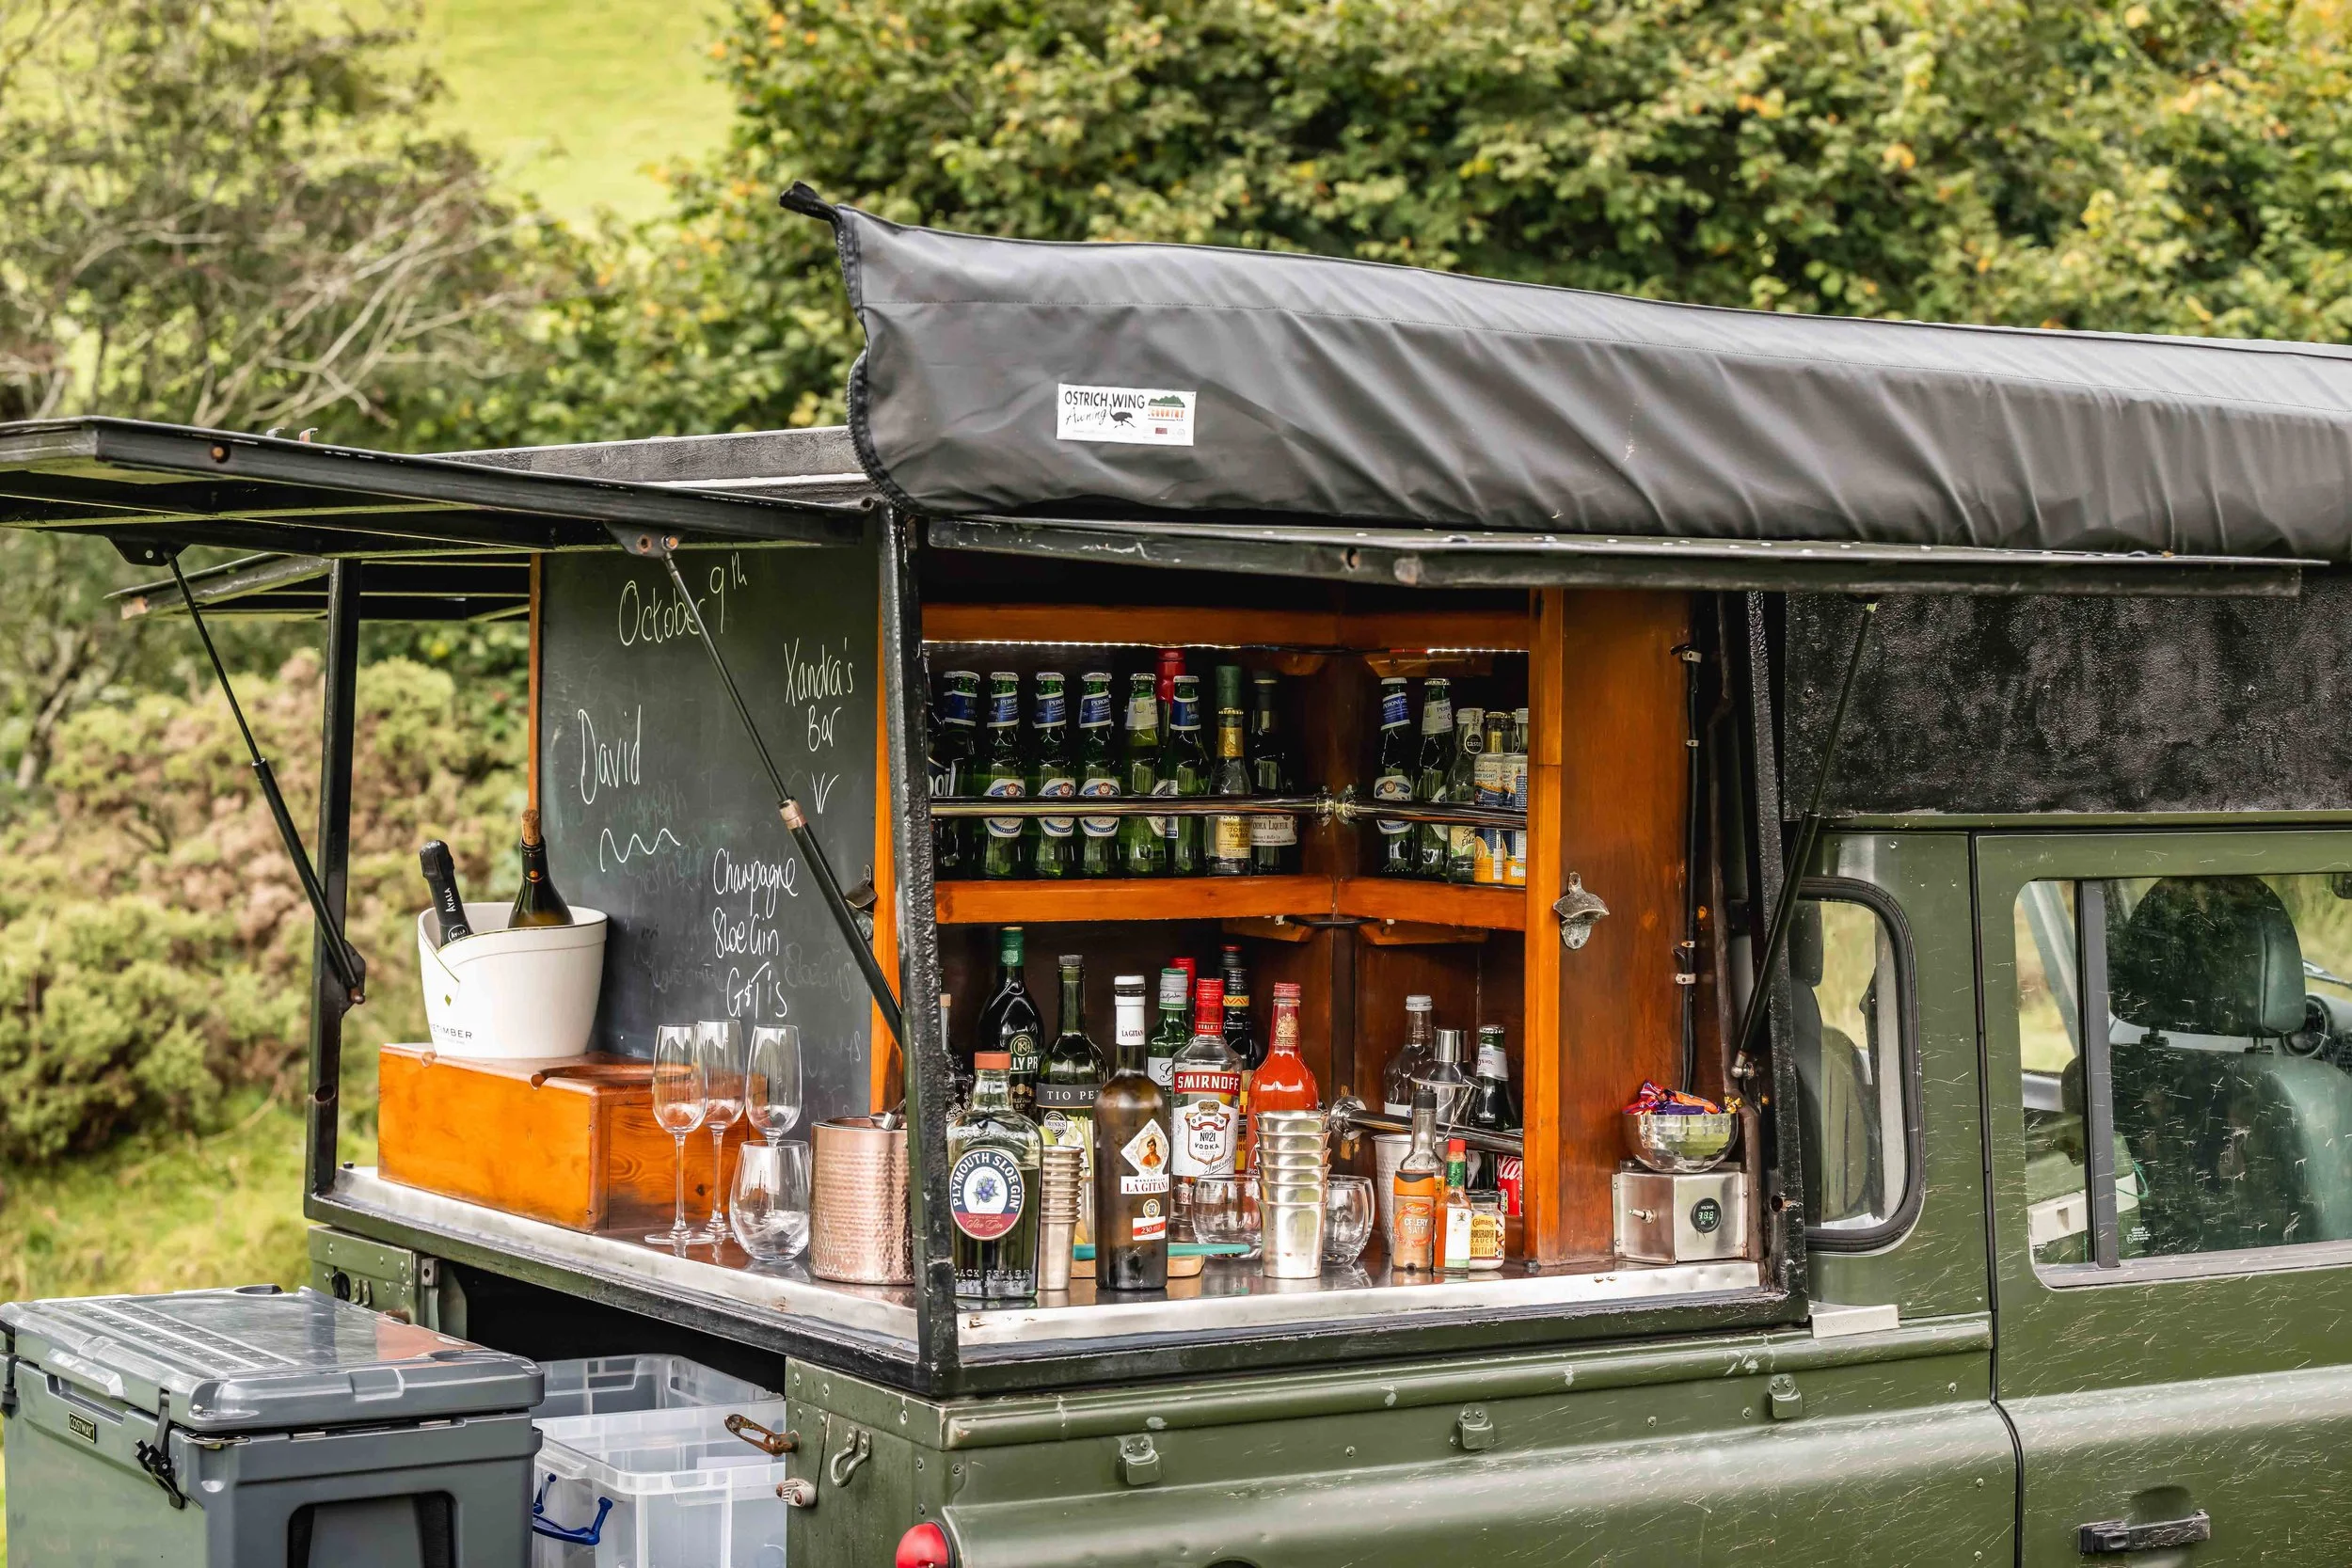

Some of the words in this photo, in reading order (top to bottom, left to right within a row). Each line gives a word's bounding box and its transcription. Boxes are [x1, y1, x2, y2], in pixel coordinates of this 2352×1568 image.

[1064, 390, 1108, 407] OSTRICH
[1111, 393, 1146, 409] WING
[807, 705, 842, 752] Bar
[578, 704, 642, 805] David
[444, 887, 456, 912] AYALA
[1177, 1074, 1239, 1091] SMIRNOFF
[1047, 1090, 1072, 1101] TIO
[1079, 1090, 1099, 1101] PE
[952, 1152, 990, 1207] PLYMOUTH
[993, 1155, 1019, 1185] SLOE
[1009, 1185, 1021, 1212] GIN
[1126, 1182, 1139, 1193] LA
[1404, 1217, 1429, 1227] CELERY
[1470, 1246, 1494, 1256] BRITAIN
[70, 1417, 93, 1438] COSTWAY
